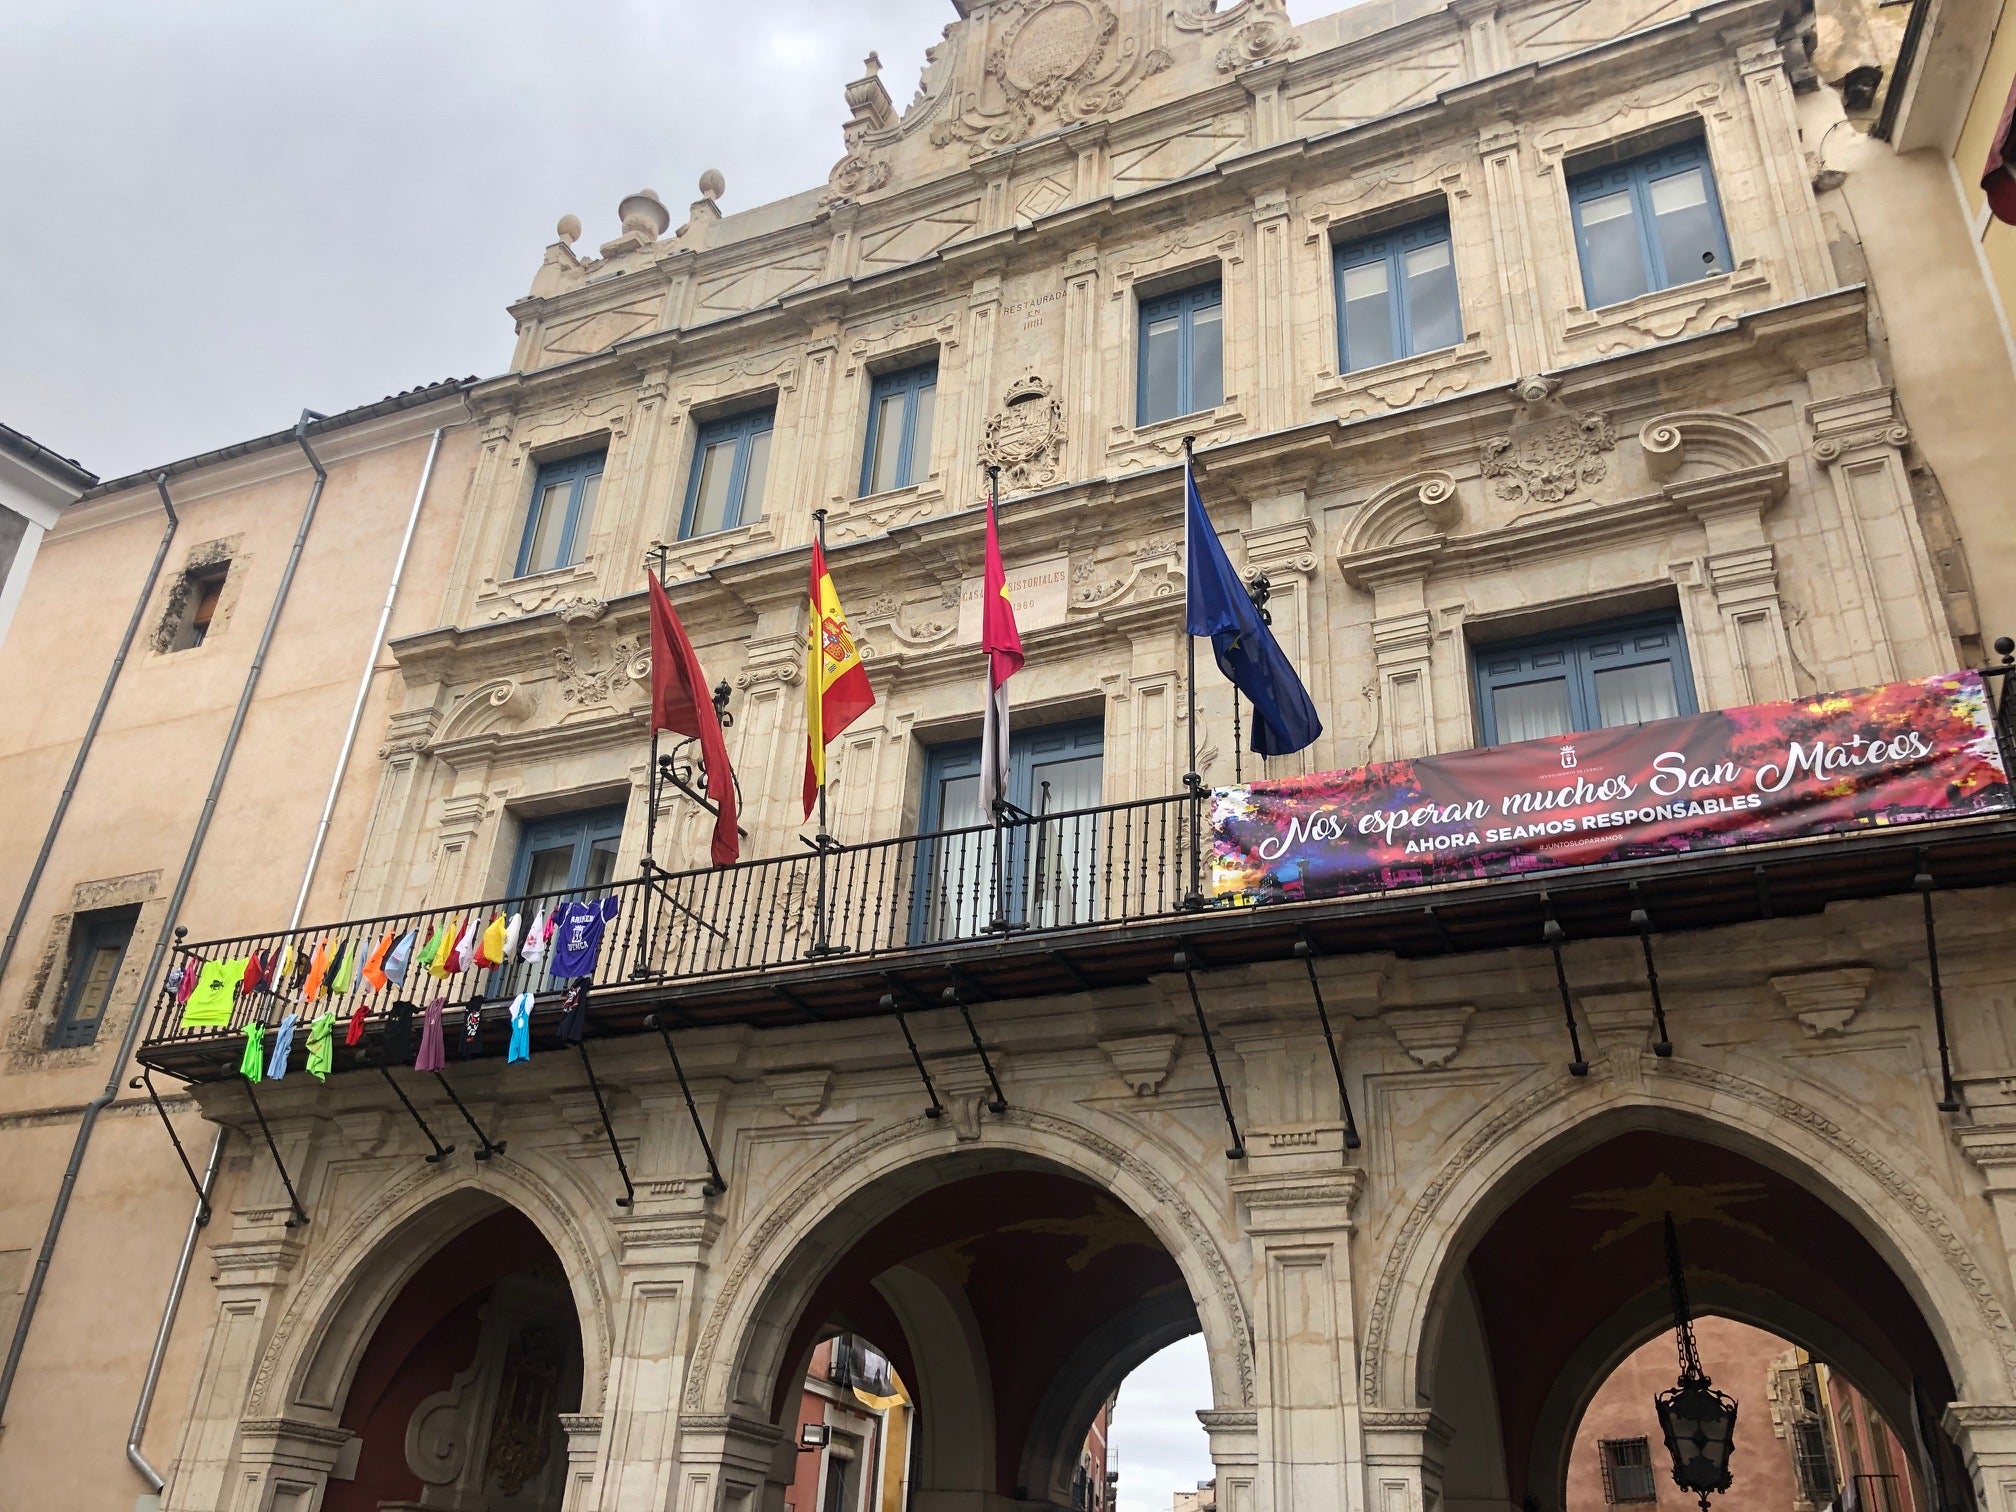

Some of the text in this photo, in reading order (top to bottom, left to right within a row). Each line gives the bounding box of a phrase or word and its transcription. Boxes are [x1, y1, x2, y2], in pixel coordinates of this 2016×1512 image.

[1008, 571, 1065, 592] SISTORIALES
[1258, 730, 1934, 860] Nos esperan muchos San Mateos
[1404, 793, 1762, 854] AHORA SEAMOS RESPONSABLES
[1539, 834, 1624, 851] #JUNTOSLOPARAMOS
